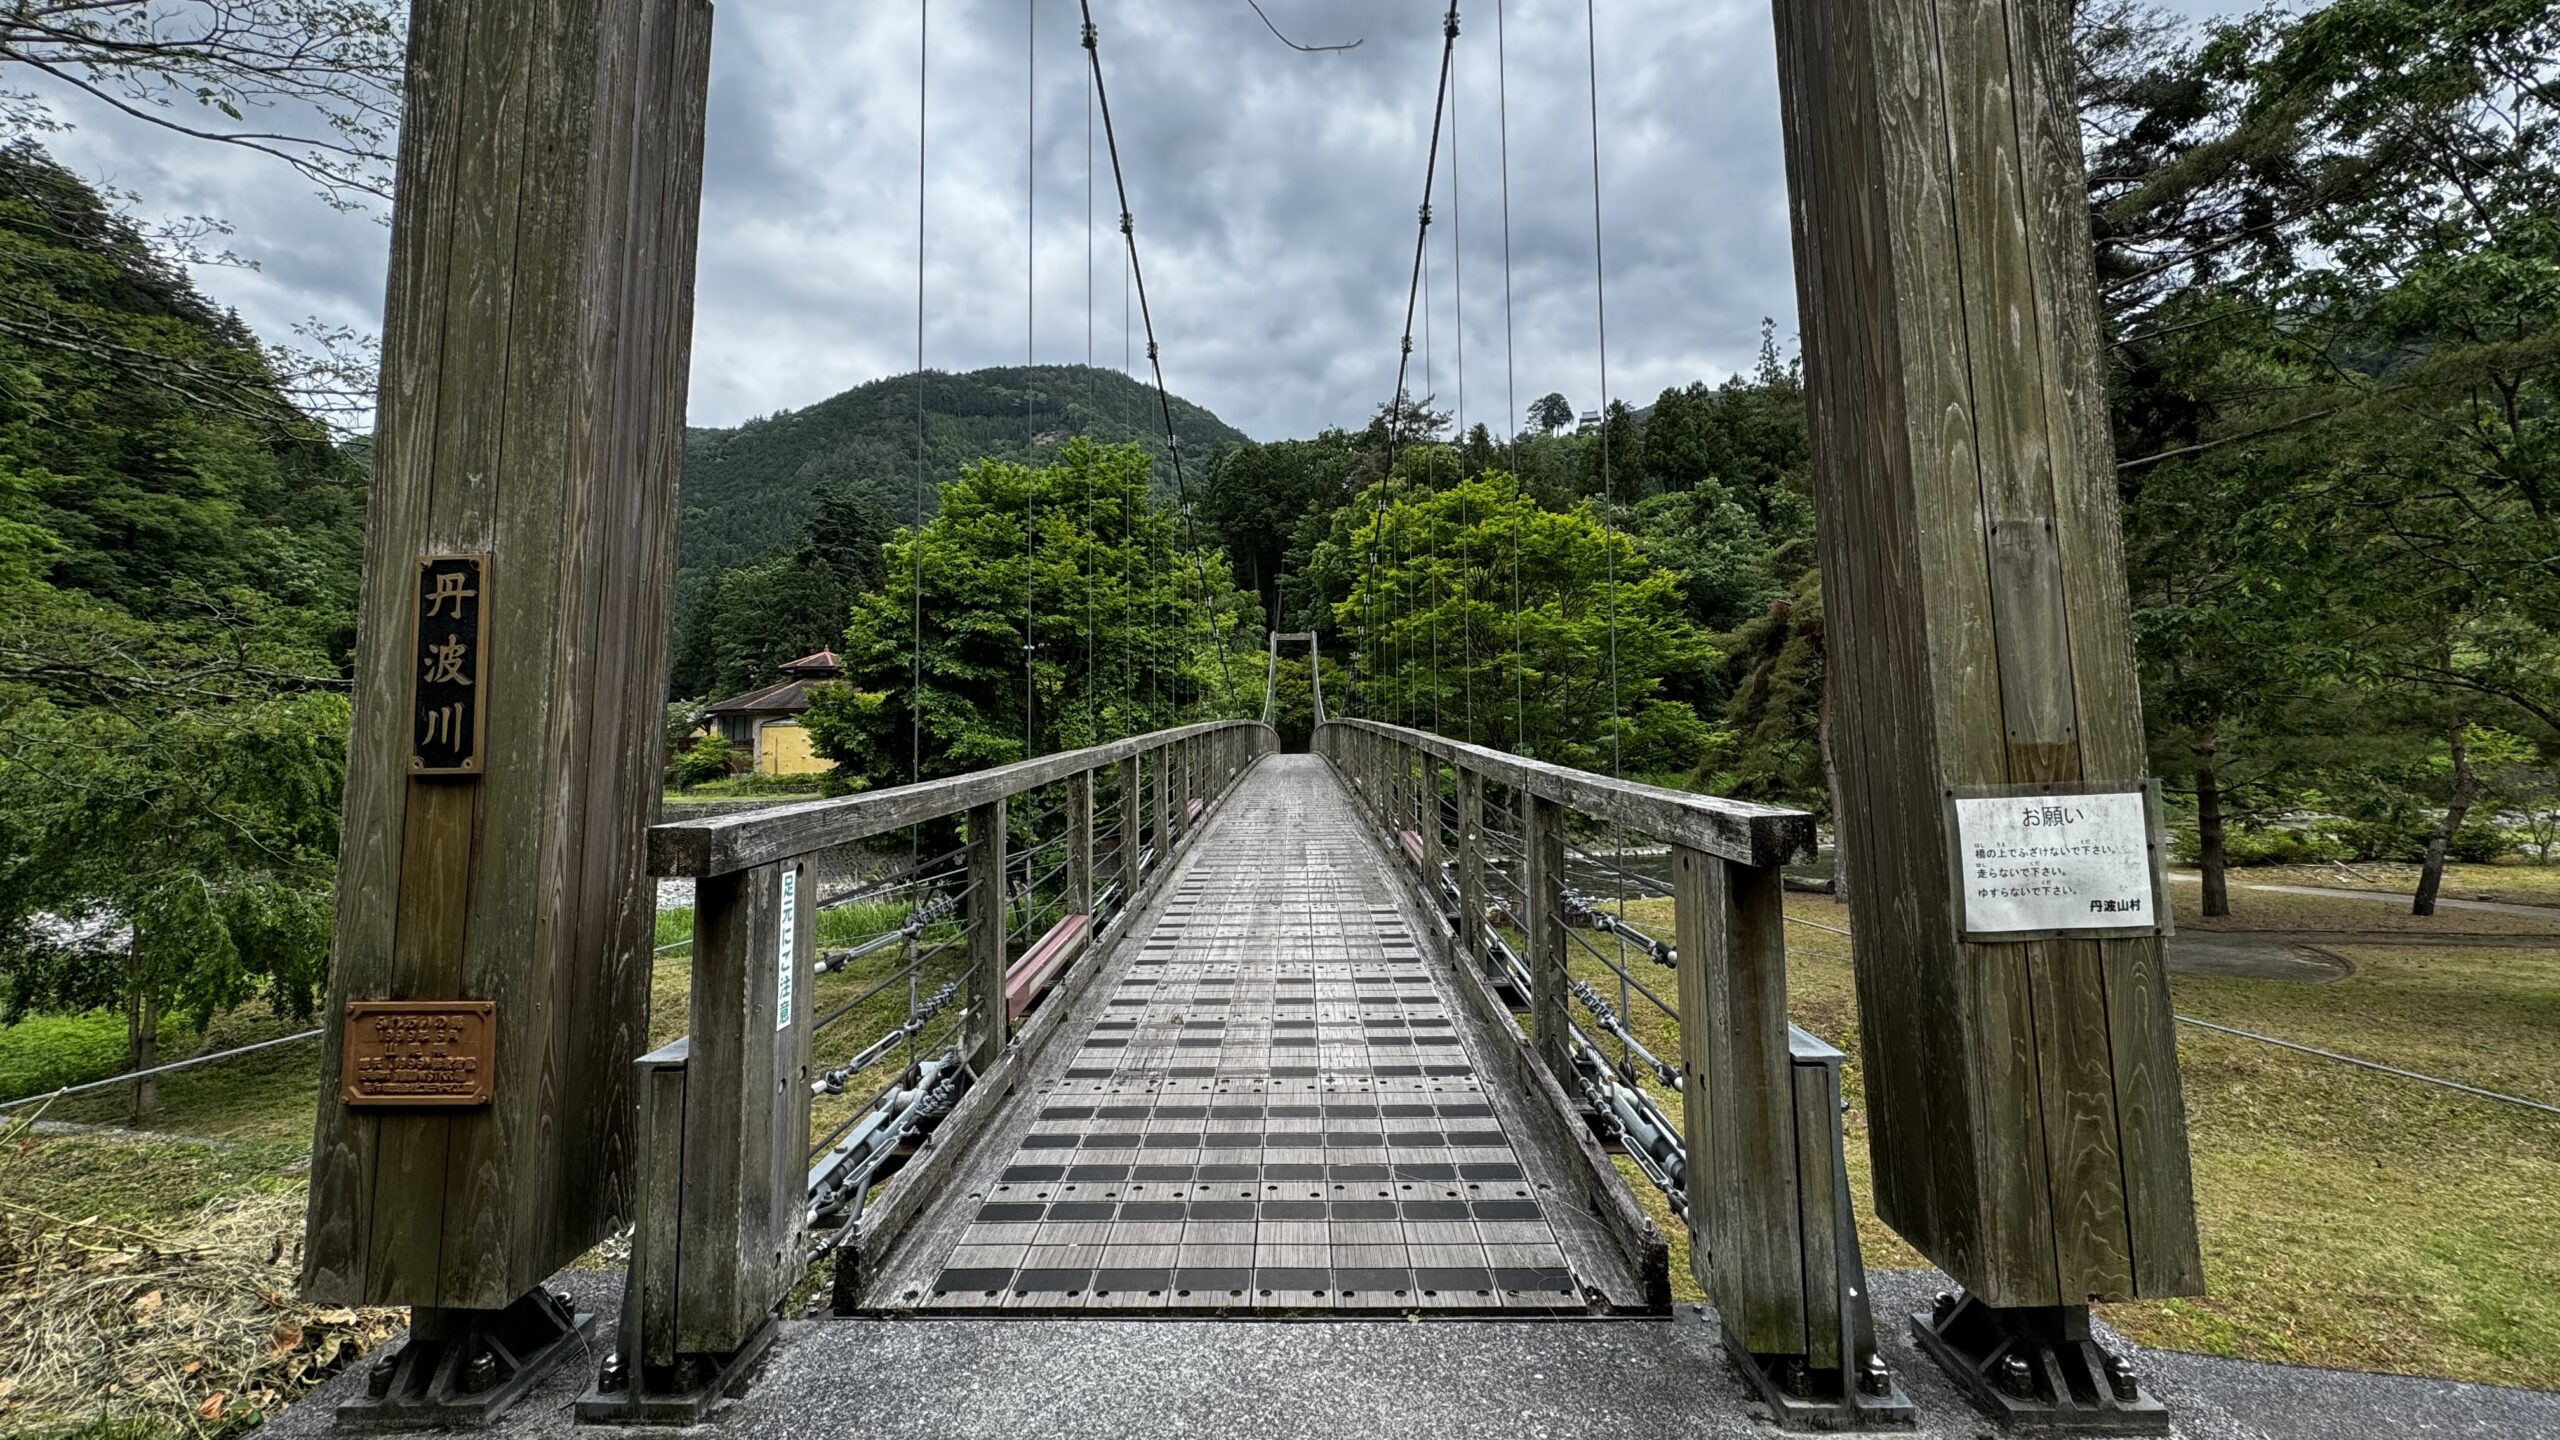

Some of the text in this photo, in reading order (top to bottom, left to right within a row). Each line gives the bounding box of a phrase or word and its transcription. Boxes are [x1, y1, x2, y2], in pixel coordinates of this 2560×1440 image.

[422, 572, 477, 753] 丹波川
[2022, 806, 2084, 827] お願い
[1977, 867, 2067, 879] 走らないで下さい。
[2090, 899, 2141, 912] 丹波山村
[779, 875, 793, 1024] 足元にご注意
